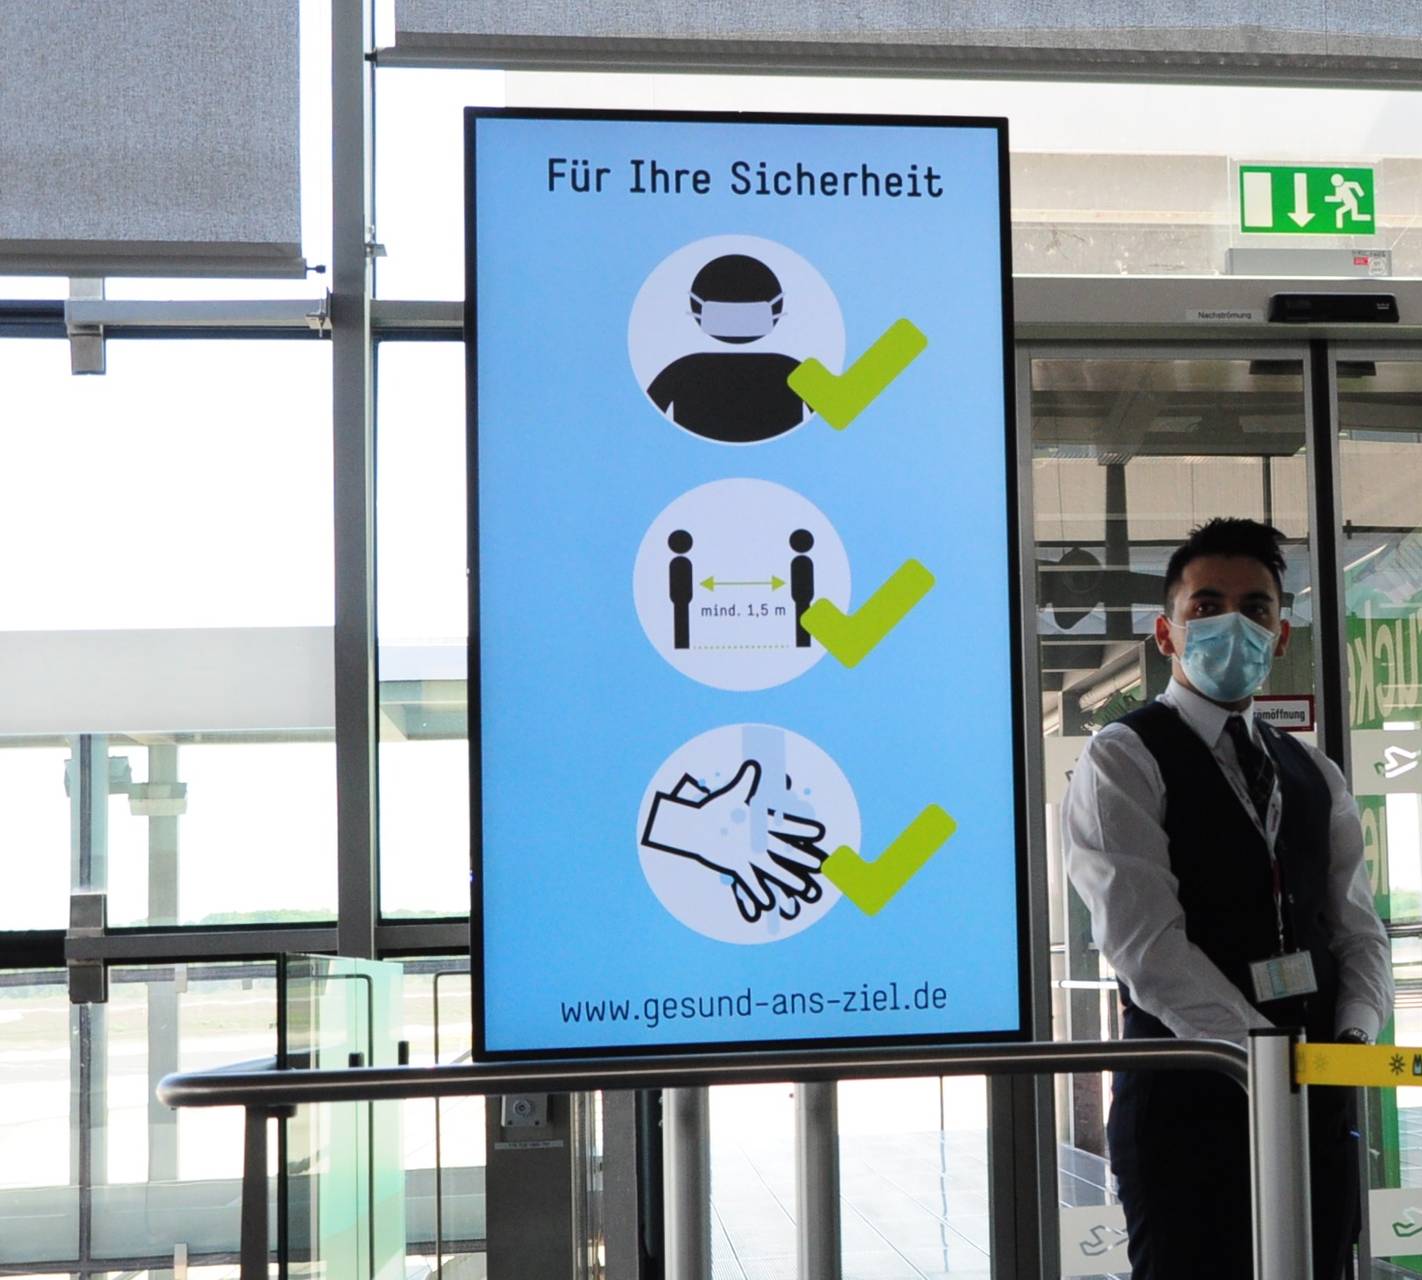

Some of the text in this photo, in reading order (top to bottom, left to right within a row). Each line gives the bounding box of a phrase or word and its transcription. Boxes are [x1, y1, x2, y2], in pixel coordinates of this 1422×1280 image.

[548, 157, 944, 198] Für Ihre Sicherheit
[700, 603, 786, 619] mind. 1,5 m
[561, 981, 947, 1029] www.gesund-ans-ziel.de
